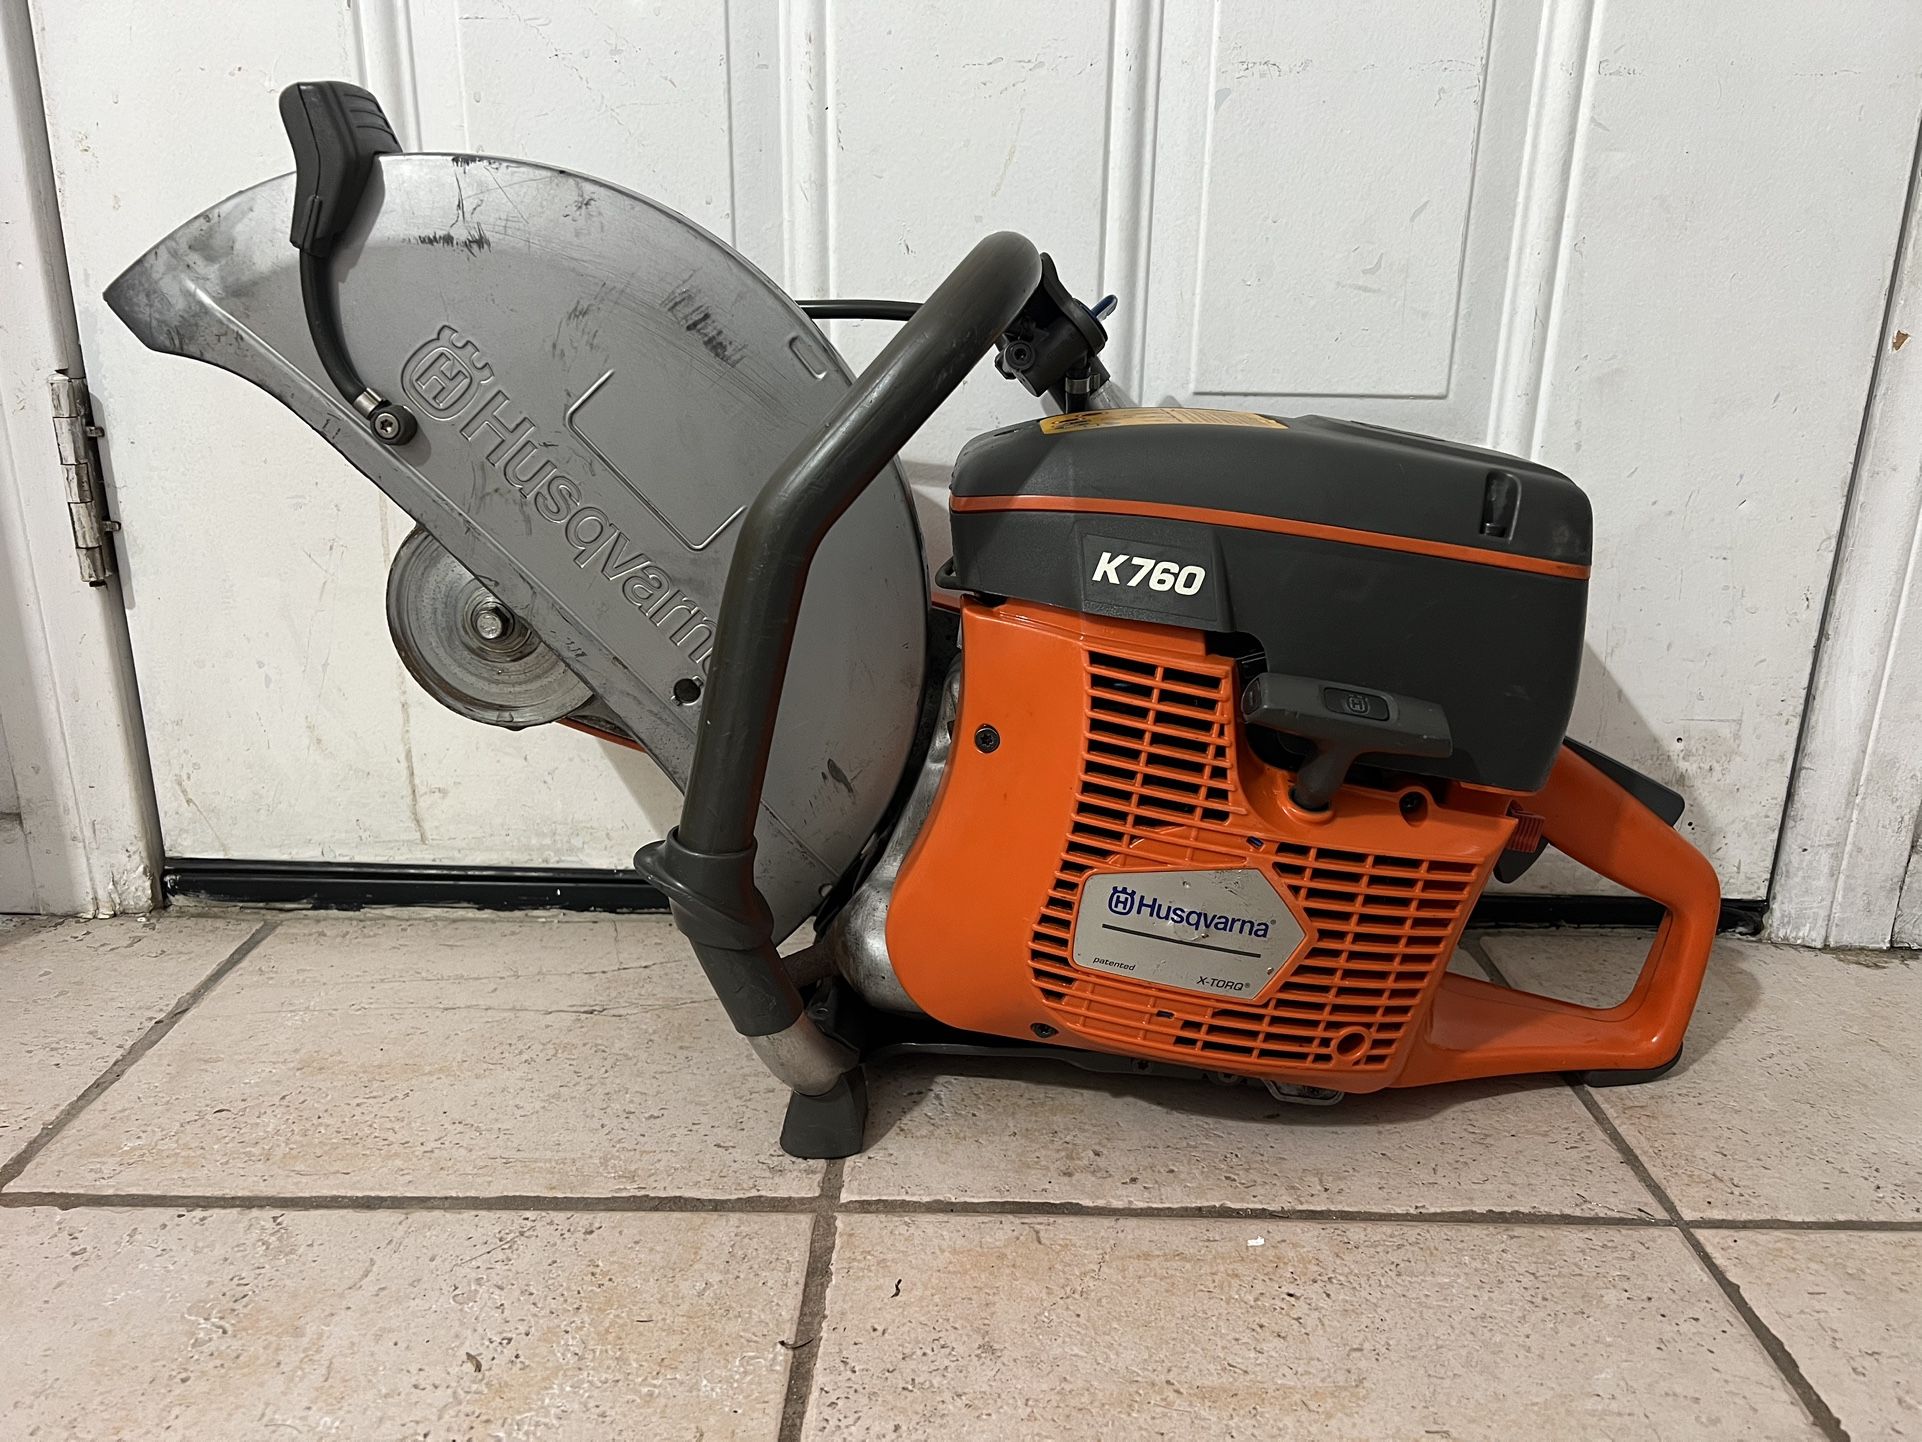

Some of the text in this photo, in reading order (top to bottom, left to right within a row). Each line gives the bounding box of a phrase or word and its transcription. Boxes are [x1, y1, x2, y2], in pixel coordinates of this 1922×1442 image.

[460, 390, 717, 675] Husqvarn
[1092, 551, 1206, 596] K760
[1093, 957, 1136, 972] patented
